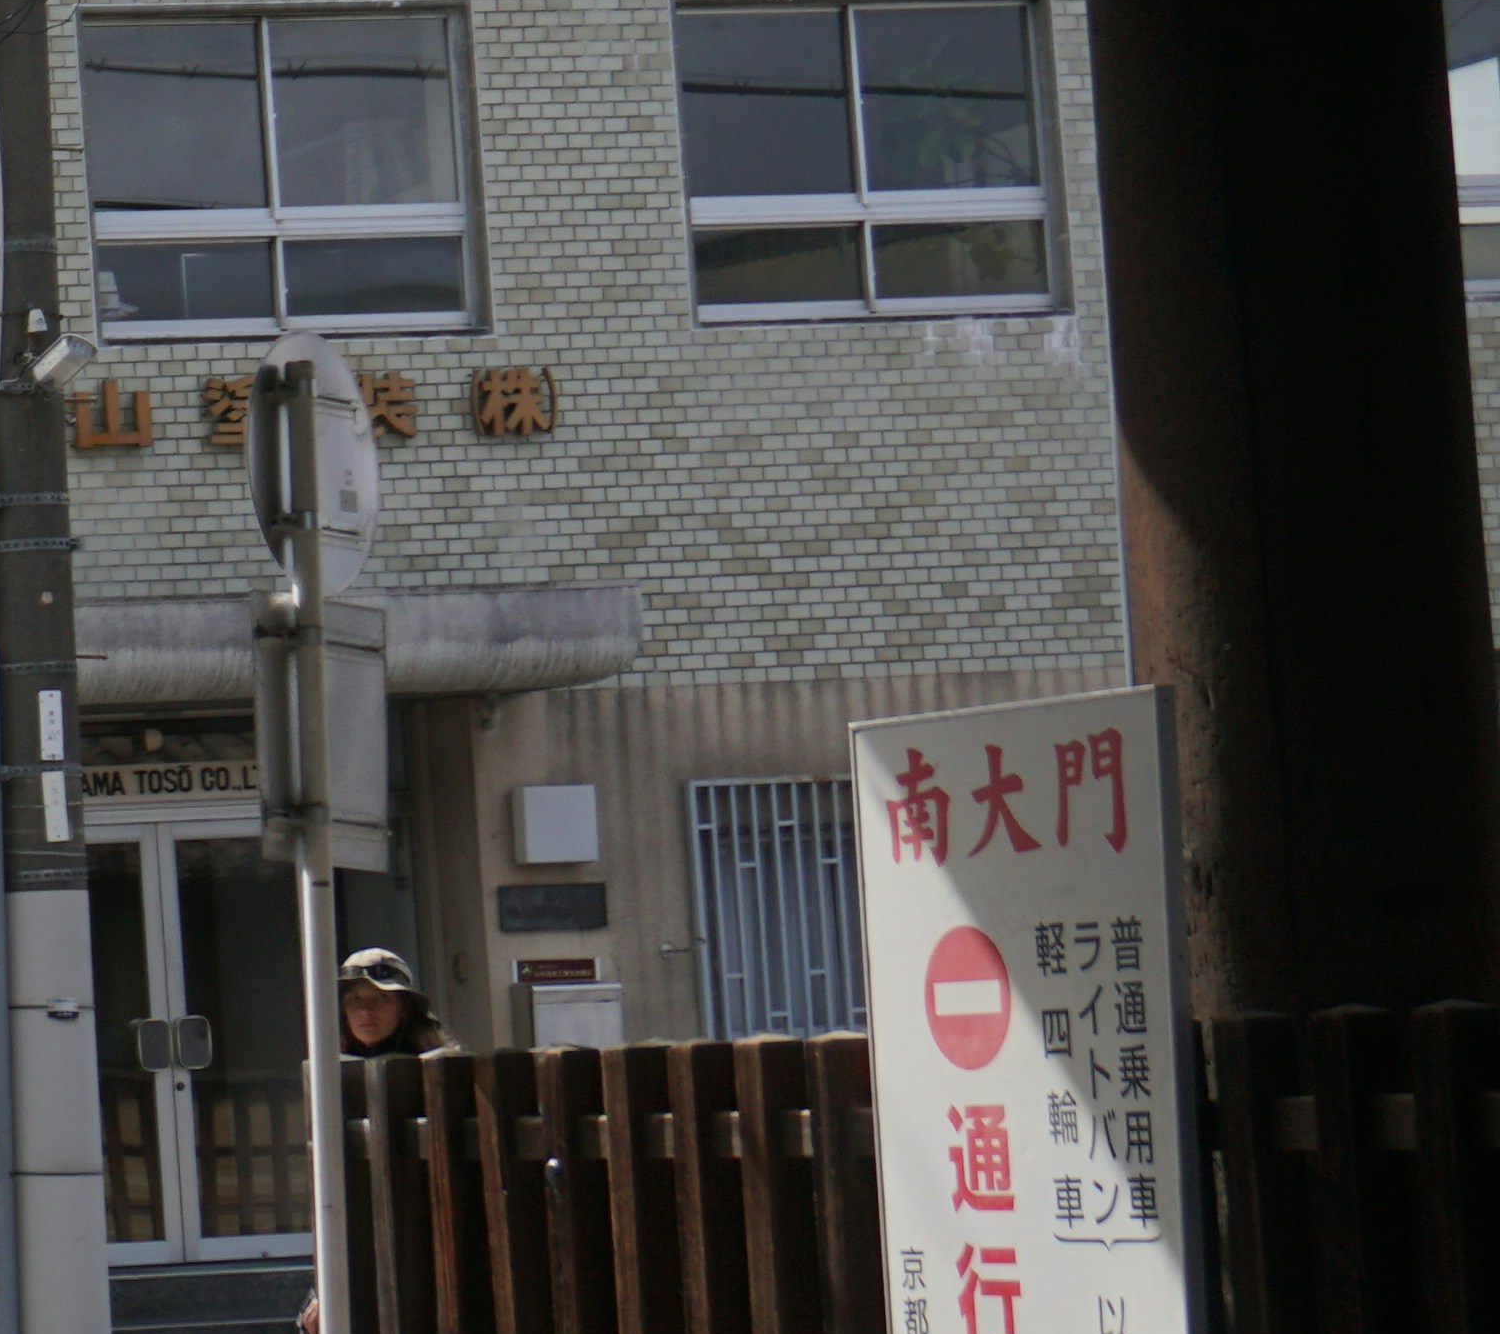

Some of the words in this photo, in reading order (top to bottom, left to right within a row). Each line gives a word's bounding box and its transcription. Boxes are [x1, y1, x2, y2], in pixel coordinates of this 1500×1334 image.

[885, 725, 1131, 868] 南大門
[1034, 921, 1088, 1228] 軽四輪車
[1072, 920, 1120, 1226] ライトバン
[1109, 914, 1161, 1229] 普通乗用車
